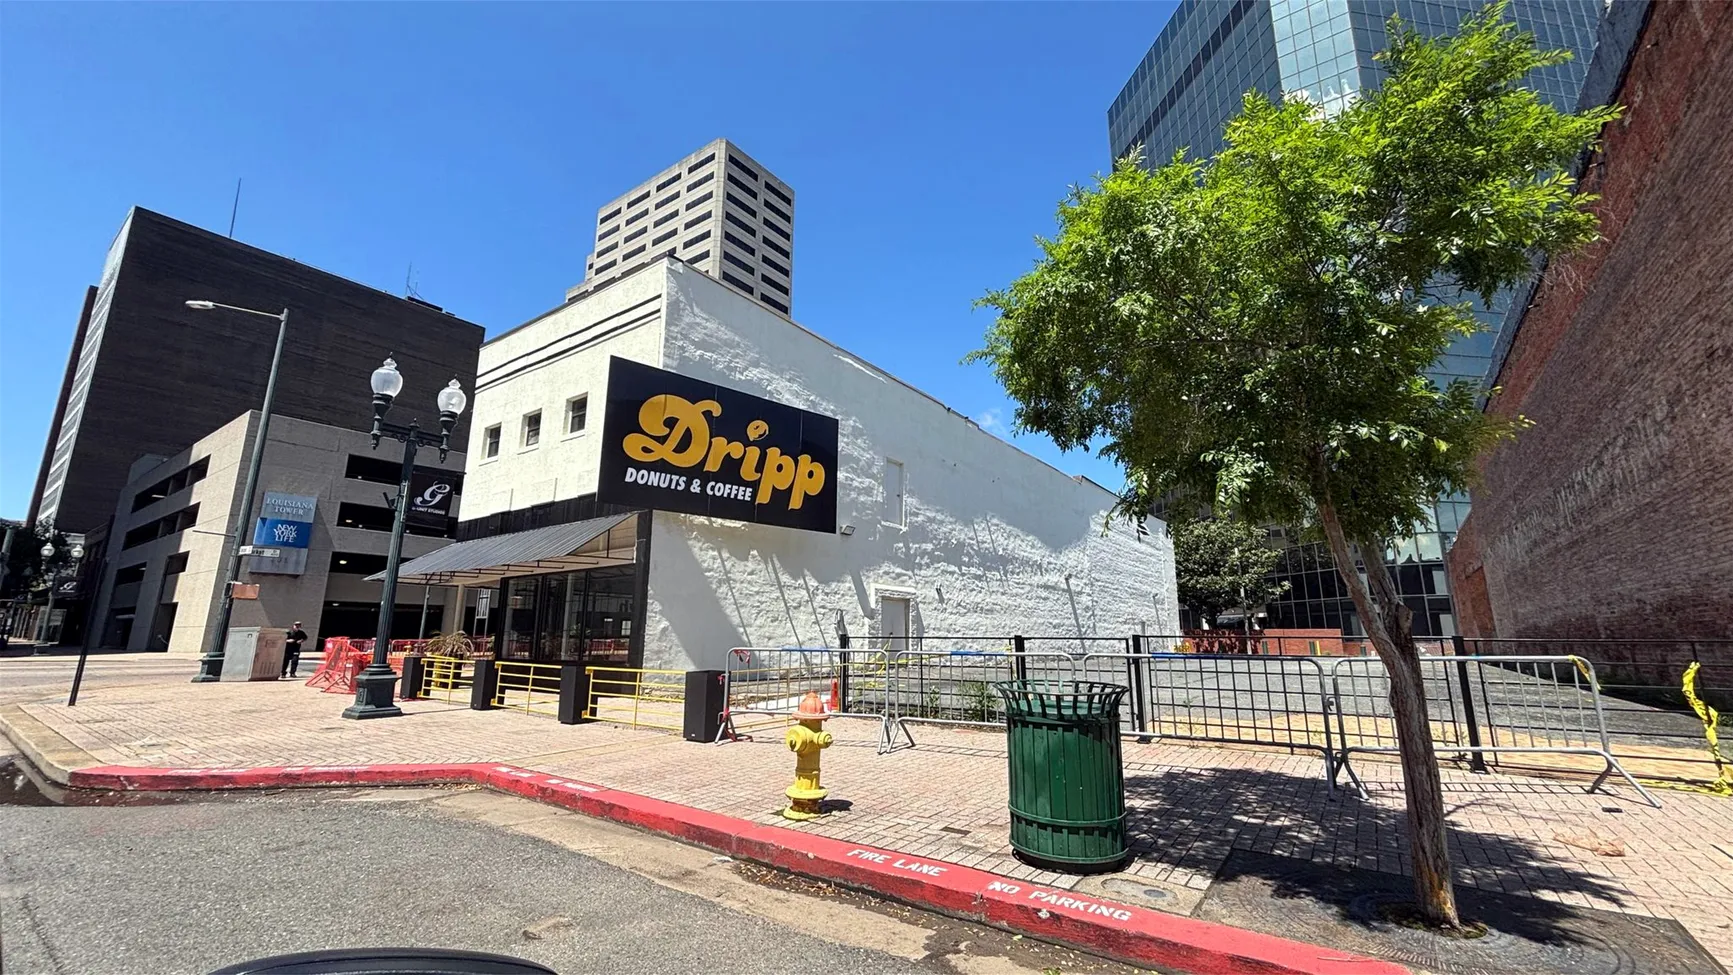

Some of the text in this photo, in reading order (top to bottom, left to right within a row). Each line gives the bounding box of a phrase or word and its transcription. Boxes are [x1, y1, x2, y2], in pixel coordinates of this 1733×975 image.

[622, 394, 826, 511] Dripp
[624, 467, 753, 502] DONUTS & COFFEE
[266, 497, 314, 510] LOUISIANA
[274, 505, 304, 516] TOWER
[273, 528, 298, 538] YORK
[277, 523, 298, 533] NEW
[275, 534, 295, 543] LIFE
[846, 849, 948, 877] FIRE LANE
[988, 880, 1132, 922] NO PARKING
